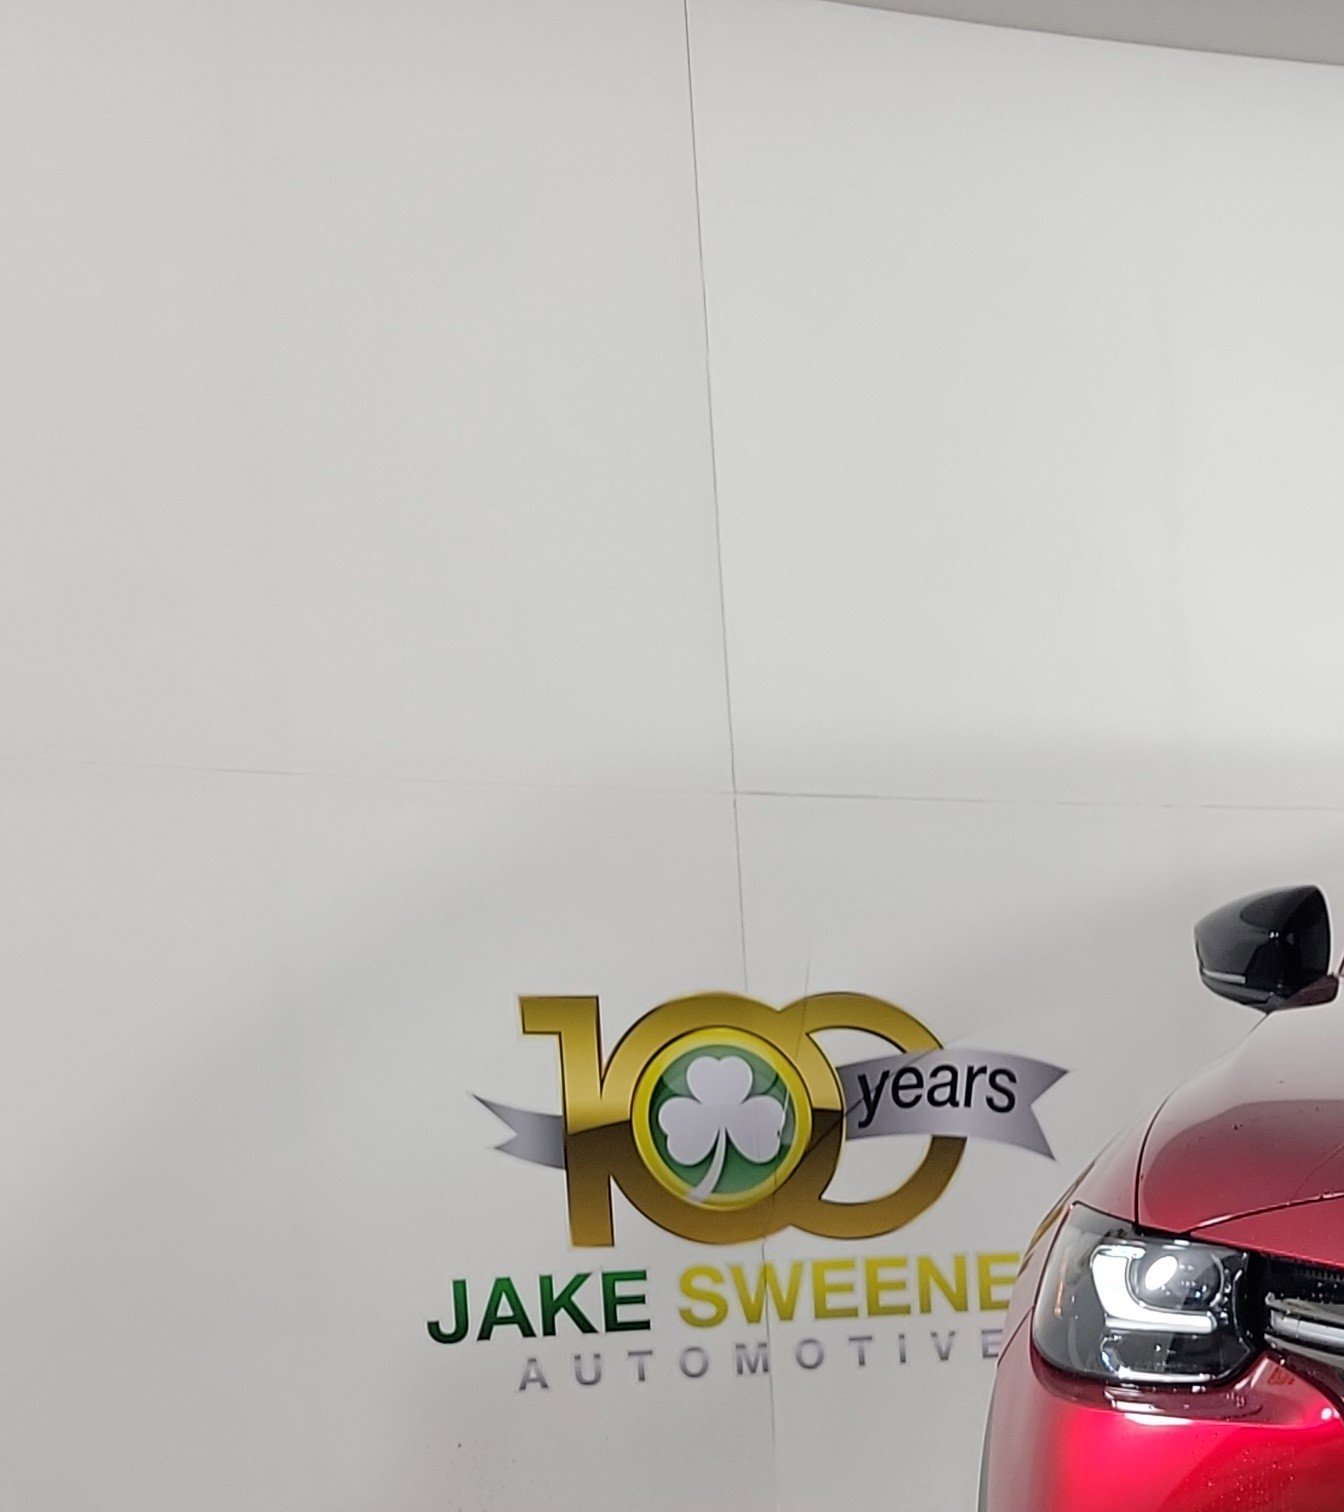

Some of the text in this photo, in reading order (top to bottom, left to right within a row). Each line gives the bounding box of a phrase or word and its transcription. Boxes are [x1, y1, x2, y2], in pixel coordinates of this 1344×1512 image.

[518, 990, 1018, 1248] 100 years
[426, 1252, 1020, 1345] JAKE SWEENE
[518, 1329, 1003, 1392] AUTOMOTIVE
